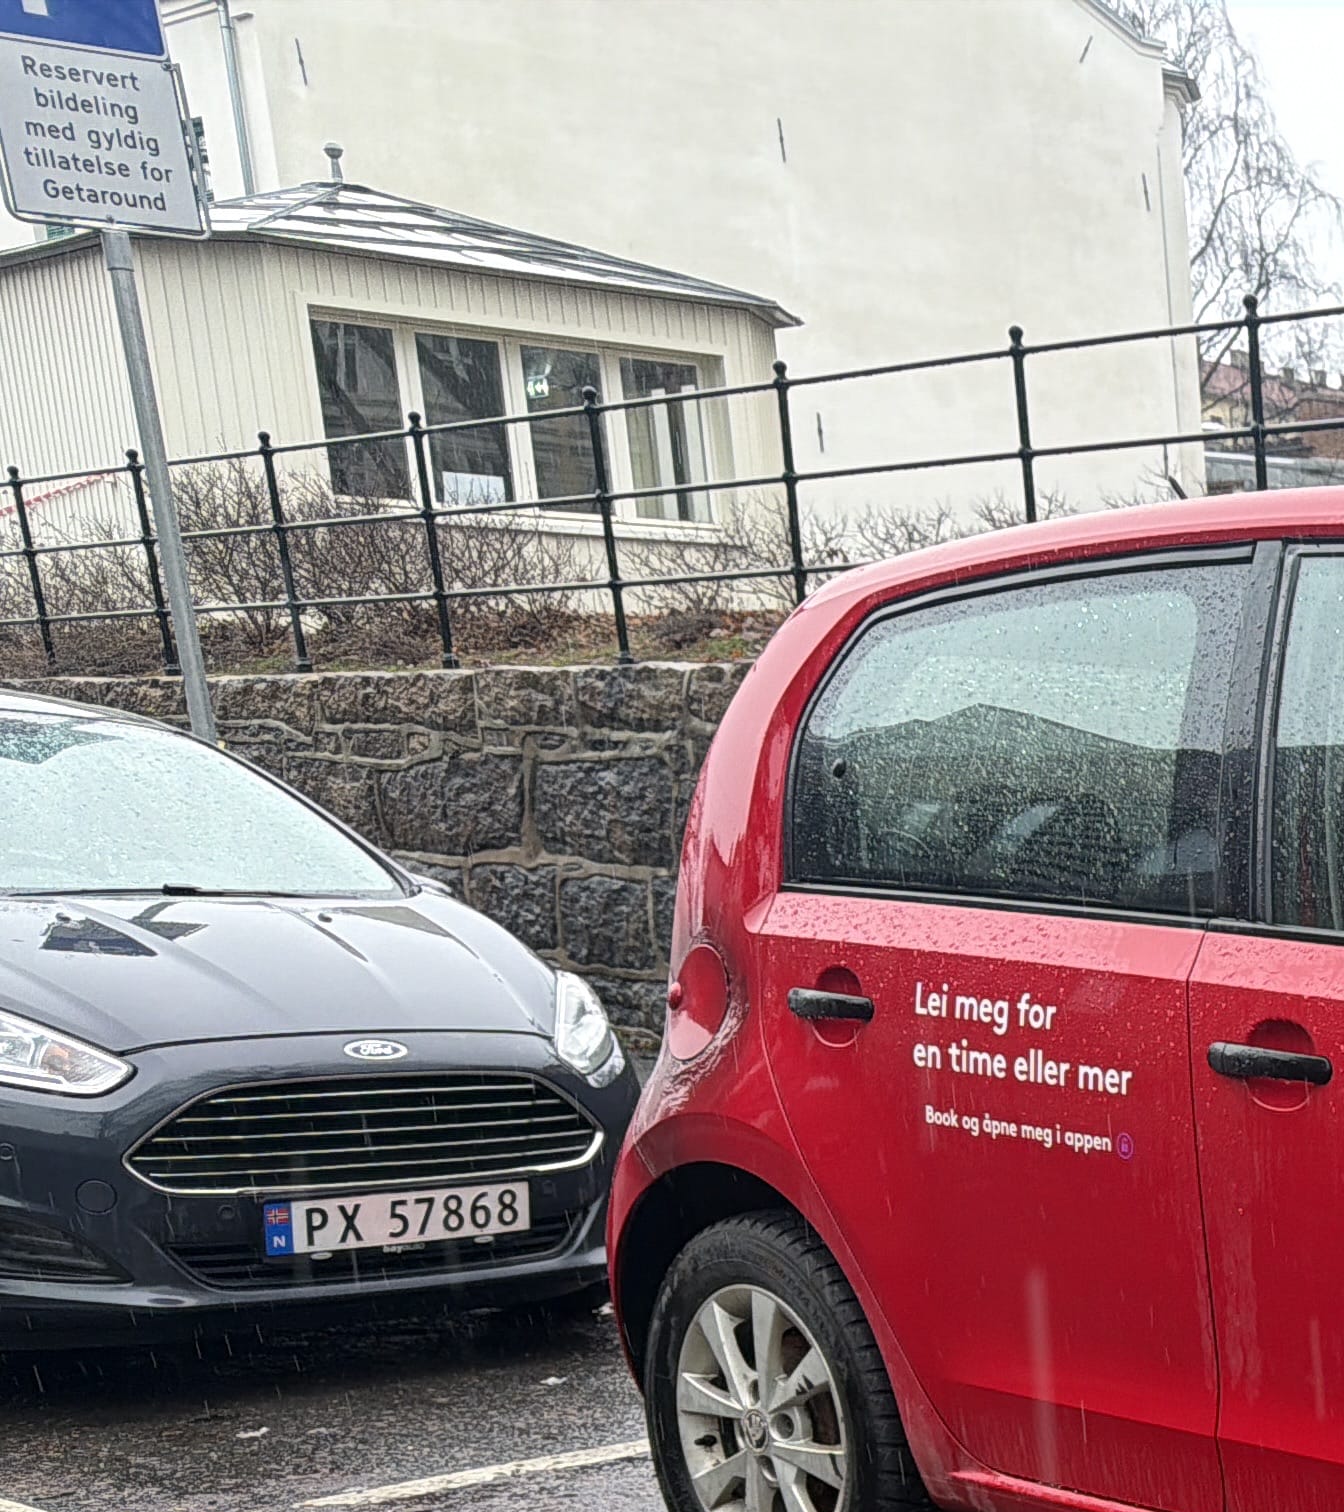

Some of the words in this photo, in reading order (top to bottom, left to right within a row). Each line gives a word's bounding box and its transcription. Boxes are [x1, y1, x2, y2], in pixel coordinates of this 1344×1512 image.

[21, 55, 140, 91] Reservert
[34, 87, 139, 124] bildeling
[25, 121, 75, 141] med
[88, 128, 160, 156] gyldig
[24, 147, 130, 177] tillatelse
[140, 161, 173, 183] for
[43, 179, 167, 211] Getaround
[914, 981, 949, 1018] Lei
[954, 994, 1009, 1035] meg
[1017, 993, 1057, 1030] for
[913, 1042, 942, 1069] en
[948, 1038, 1007, 1079] time
[1014, 1048, 1070, 1086] eller
[1078, 1063, 1133, 1095] mer
[925, 1104, 959, 1128] Book
[962, 1117, 979, 1136] og
[983, 1113, 1017, 1139] åpne
[1021, 1123, 1052, 1148] meg
[1055, 1124, 1061, 1144] i
[1064, 1131, 1112, 1154] appen
[305, 1203, 364, 1246] PX
[389, 1189, 518, 1238] 57868
[273, 1236, 286, 1248] N
